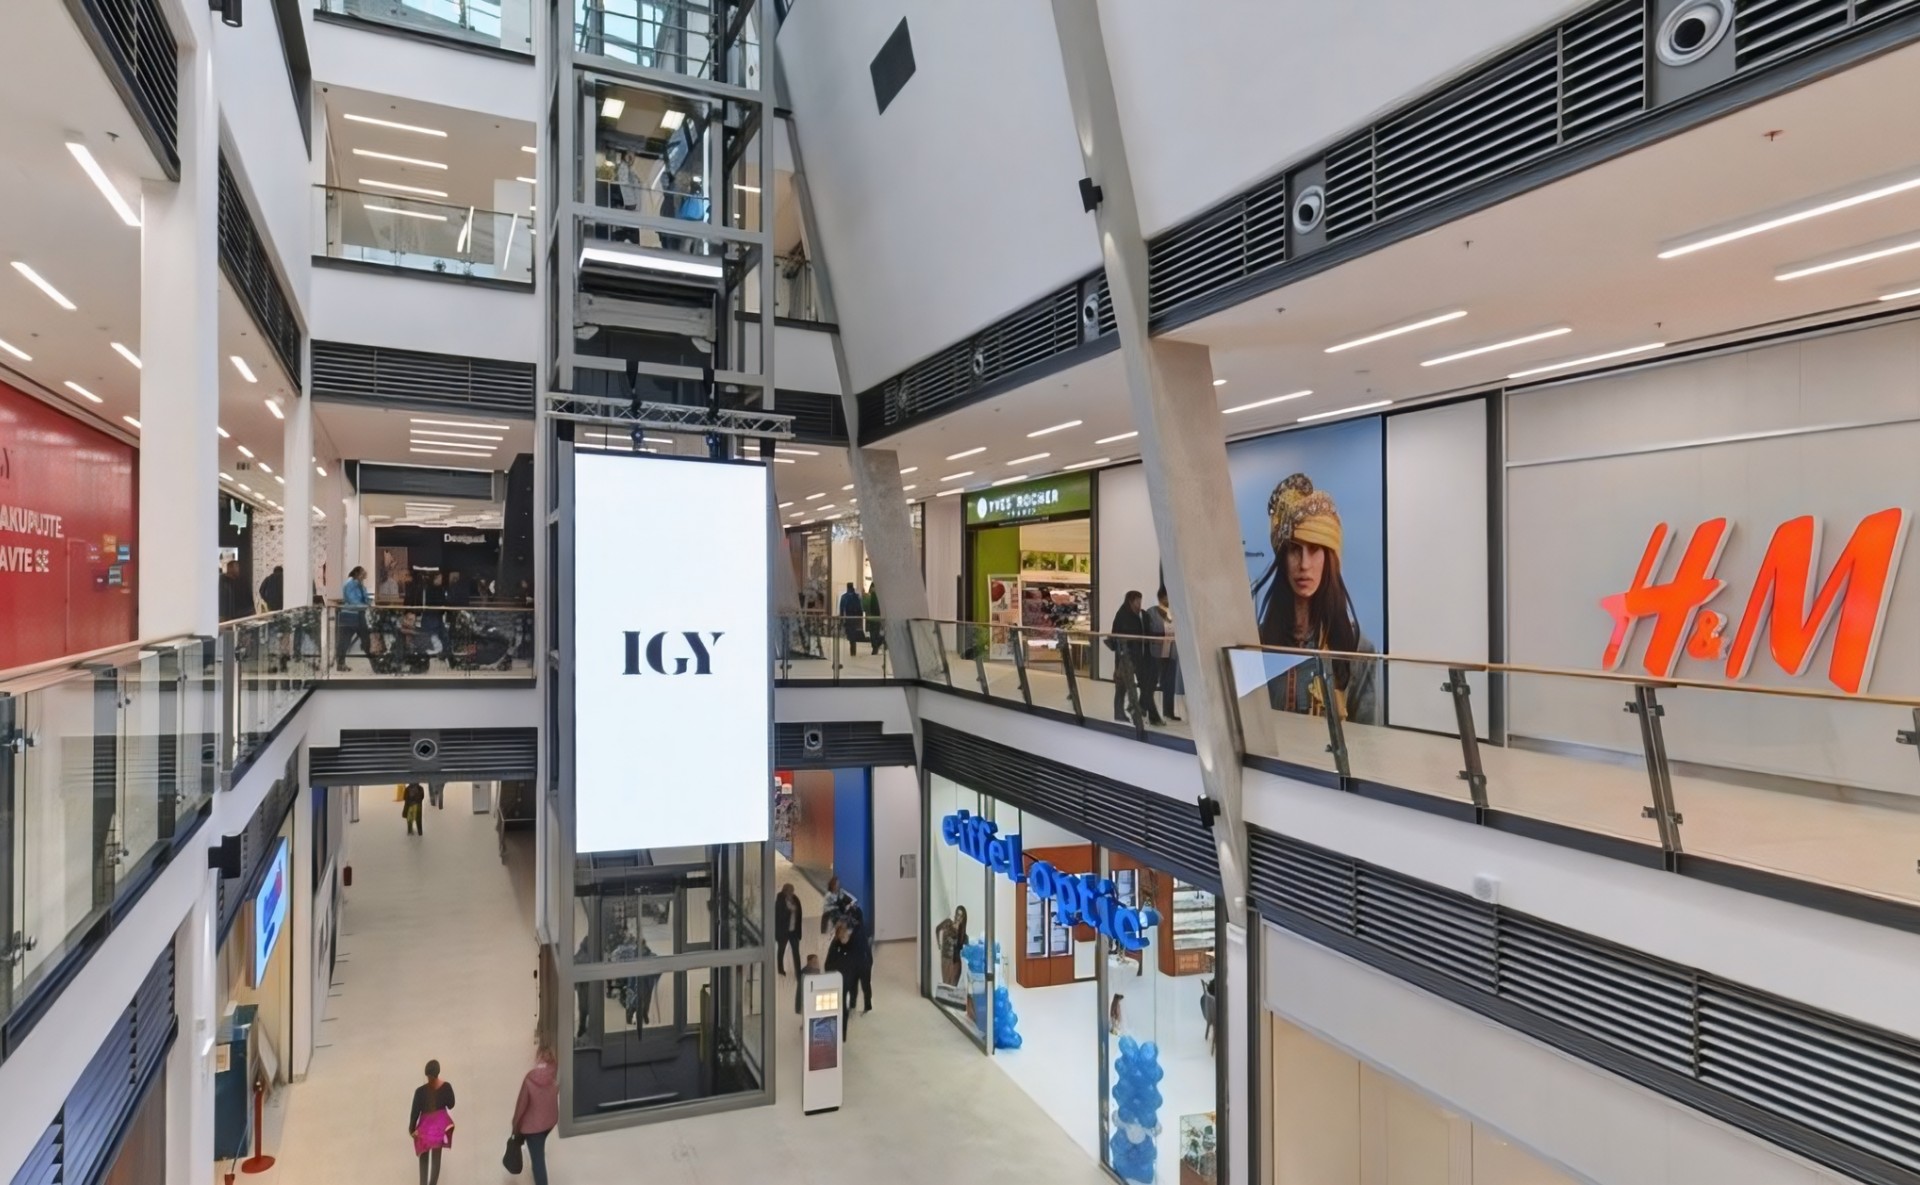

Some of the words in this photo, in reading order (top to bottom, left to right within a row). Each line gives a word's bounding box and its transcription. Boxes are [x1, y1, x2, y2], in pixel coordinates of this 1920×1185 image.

[989, 496, 1012, 513] YVES
[1017, 489, 1059, 508] ROCHER
[35, 548, 50, 573] SE
[1600, 507, 1907, 694] H&M
[622, 630, 725, 675] IGY
[942, 809, 1026, 883] eiffel
[1029, 860, 1150, 951] optic
